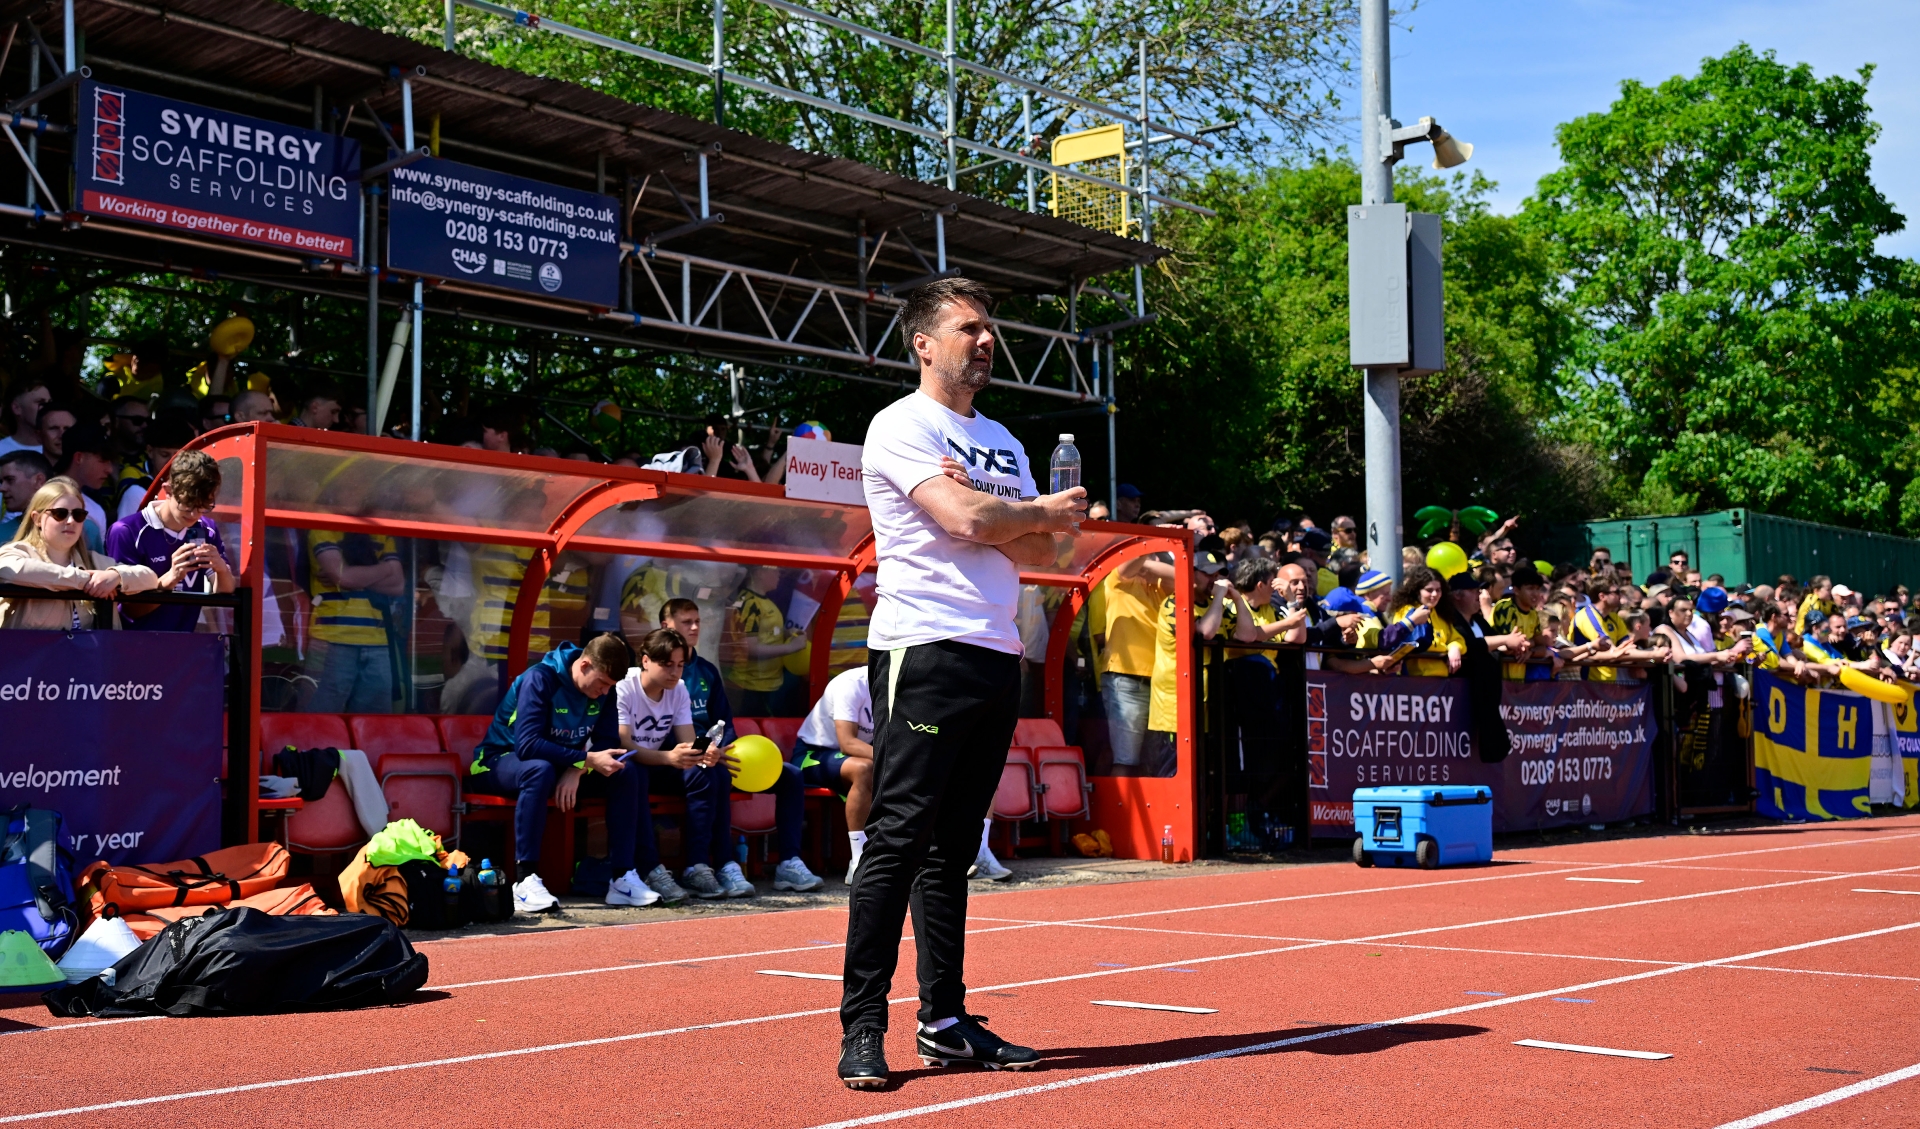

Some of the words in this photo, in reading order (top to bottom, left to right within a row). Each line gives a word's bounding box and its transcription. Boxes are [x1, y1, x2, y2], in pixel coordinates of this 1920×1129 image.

[160, 109, 322, 165] SYNERGY
[132, 135, 347, 201] SCAFFOLDING
[169, 173, 314, 215] SERVICES
[393, 167, 614, 223] www.synergy-scaffolding.co.uk
[99, 195, 167, 223] Working
[171, 205, 239, 234] together
[242, 218, 265, 238] for
[268, 224, 291, 243] the
[295, 228, 345, 253] better!
[391, 184, 616, 244] info@synergy-scaffolding.co.uk
[445, 219, 488, 245] 0208
[493, 228, 524, 252] 153
[528, 235, 569, 260] 0773
[451, 248, 487, 266] CHAS
[787, 455, 828, 482] Away
[0, 677, 32, 700] ed
[37, 680, 61, 701] to
[66, 677, 164, 701] investors
[1350, 692, 1454, 723] SYNERGY
[1768, 686, 1787, 734] D
[1837, 704, 1858, 750] H
[1332, 728, 1471, 758] SCAFFOLDING
[0, 764, 121, 793] velopment
[1357, 764, 1450, 782] SERVICES
[1521, 759, 1555, 785] 0208
[1557, 757, 1580, 783] 153
[1582, 756, 1612, 782] 0773
[95, 831, 144, 857] year
